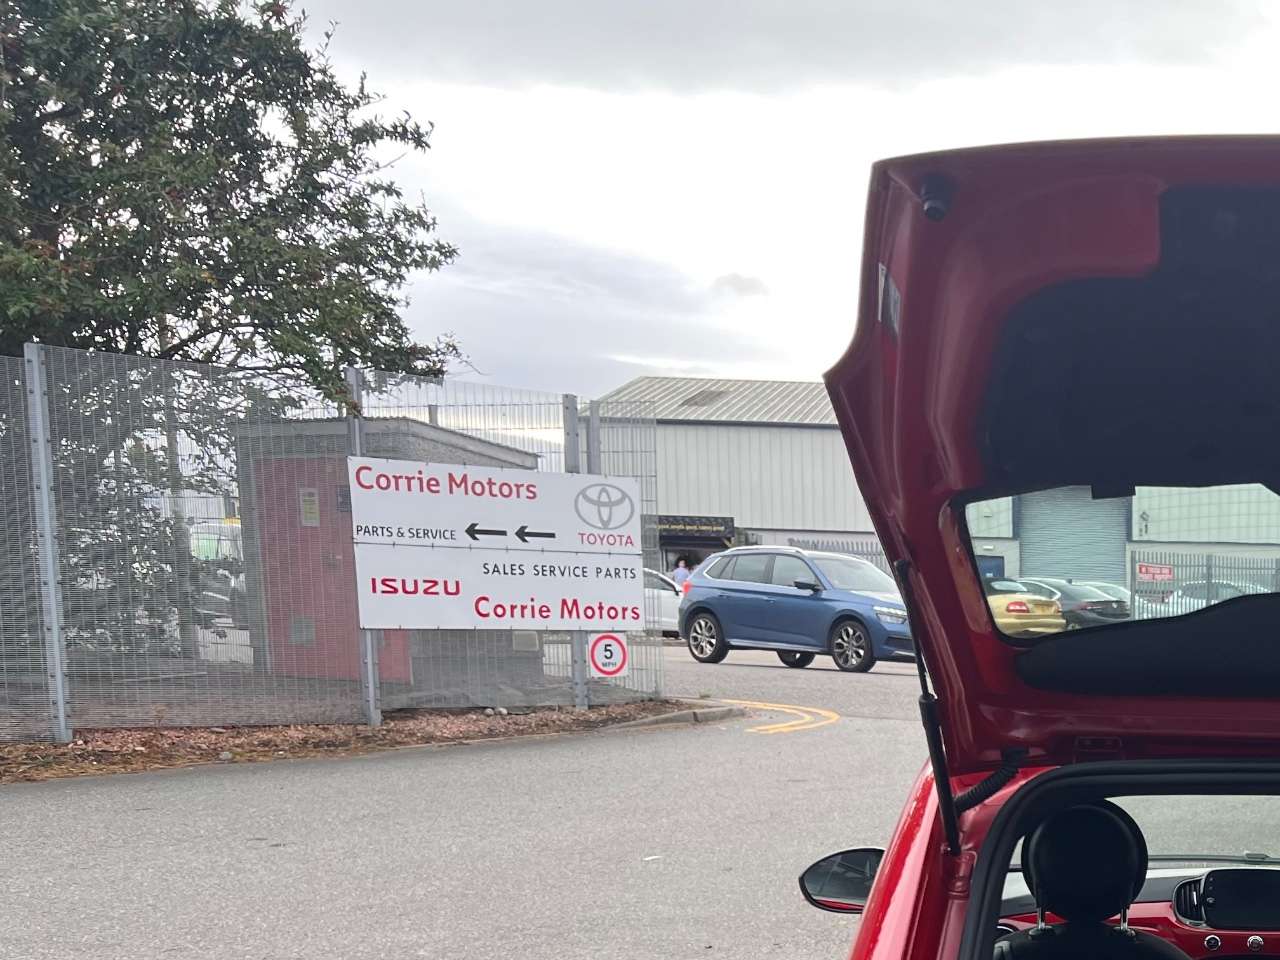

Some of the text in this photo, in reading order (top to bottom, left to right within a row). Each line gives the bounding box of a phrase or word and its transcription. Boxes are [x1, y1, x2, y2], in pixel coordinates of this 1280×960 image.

[355, 465, 538, 500] Corrie Motors
[356, 525, 456, 541] PARTS & SERVICE
[578, 532, 634, 547] TOYOTA
[482, 562, 637, 579] SALES SERVICE PARTS
[370, 577, 461, 596] ISUZU
[474, 596, 641, 621] Corrie Motors
[604, 643, 613, 660] 5
